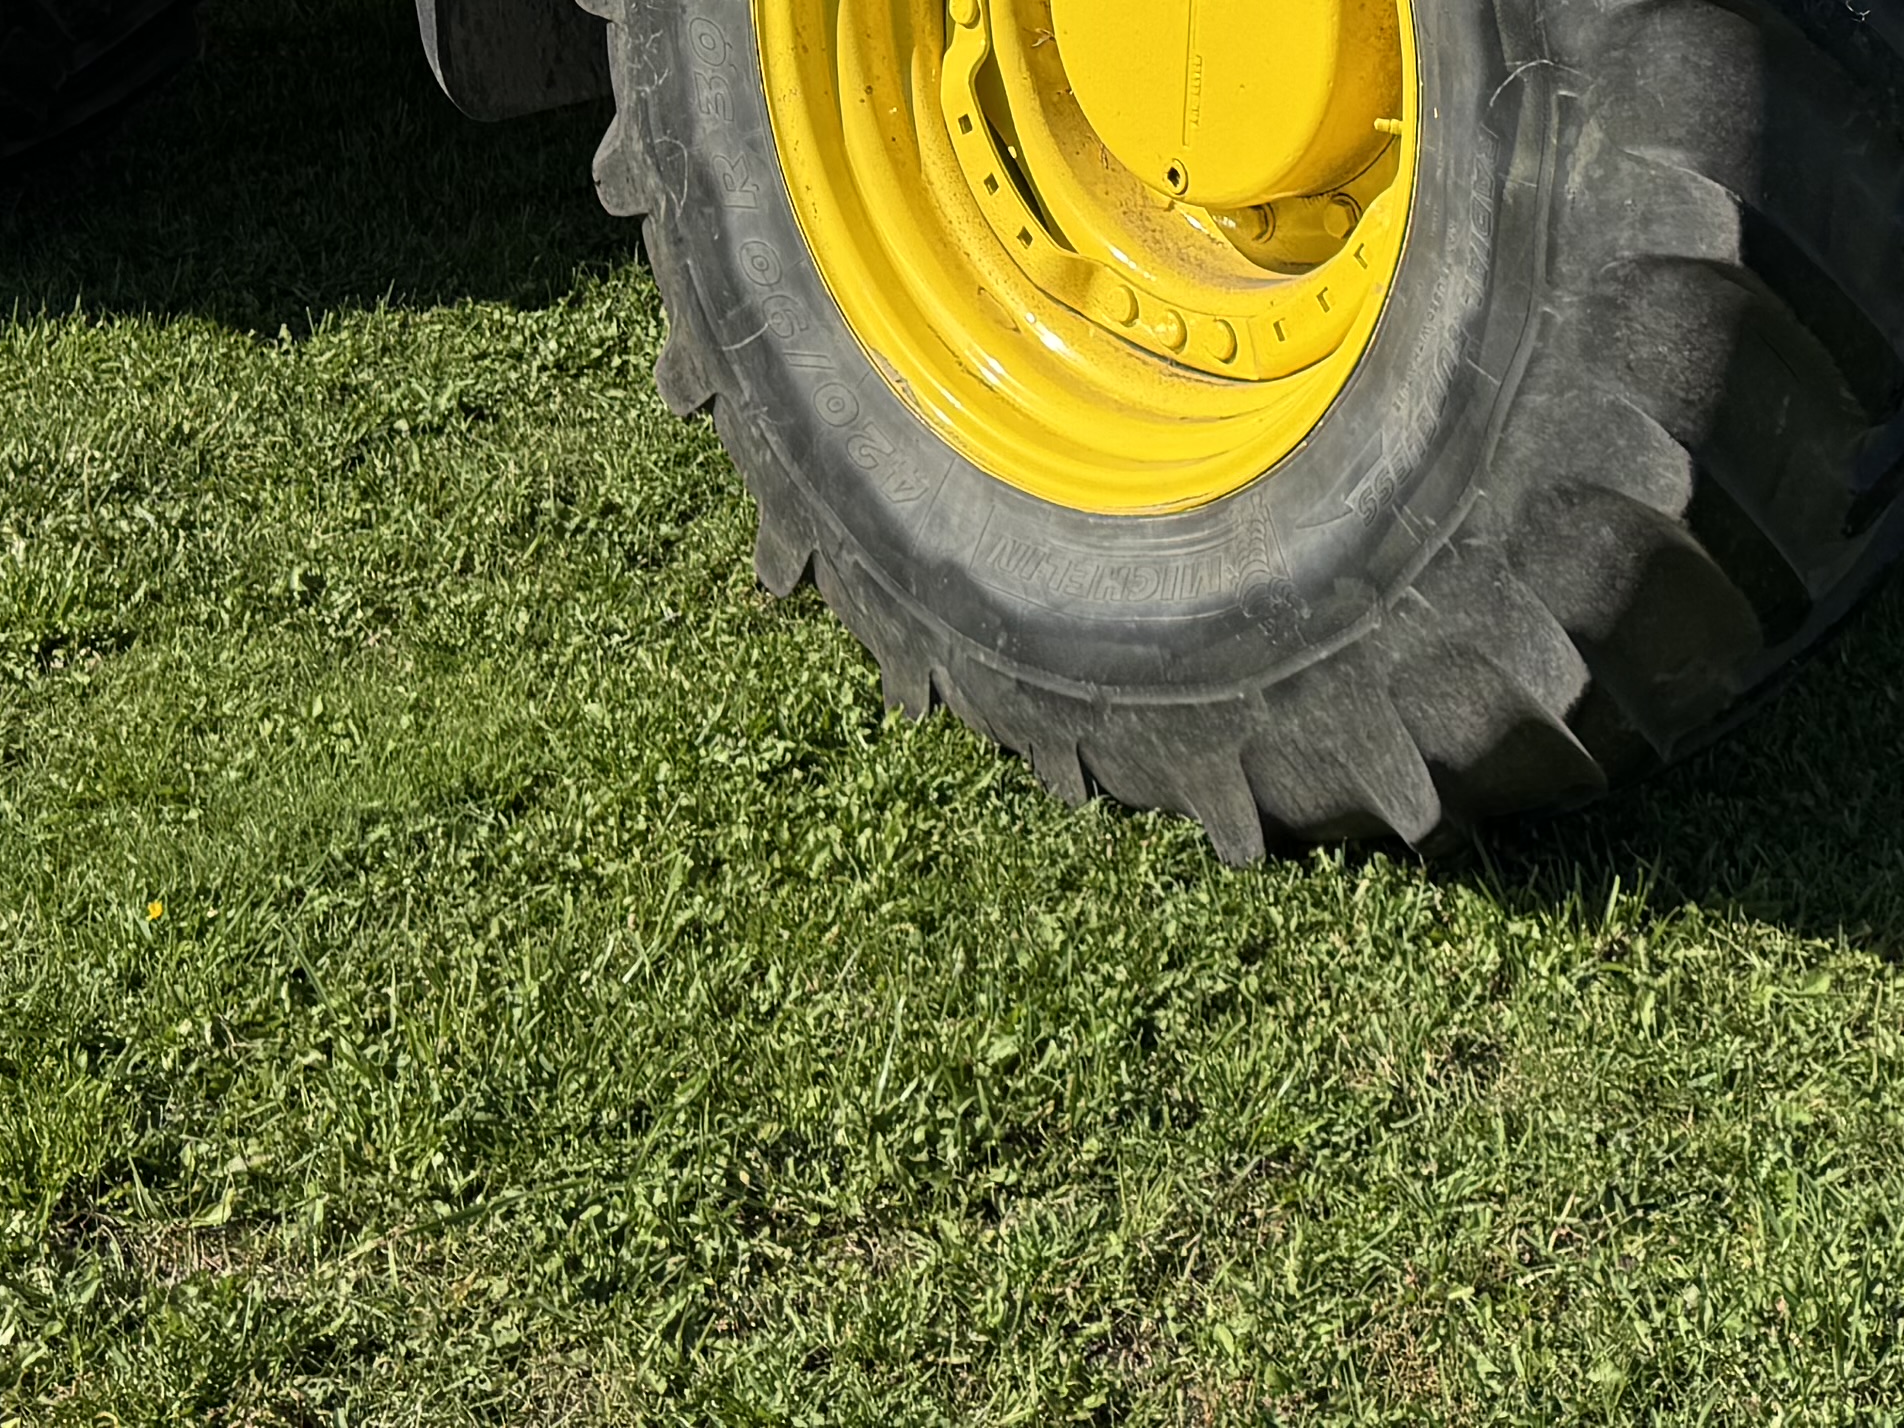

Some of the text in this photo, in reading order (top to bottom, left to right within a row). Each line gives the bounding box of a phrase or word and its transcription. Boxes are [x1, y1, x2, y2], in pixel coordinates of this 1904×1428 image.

[688, 17, 930, 504] 420/90 R 30
[986, 538, 1224, 603] MICHELIN
